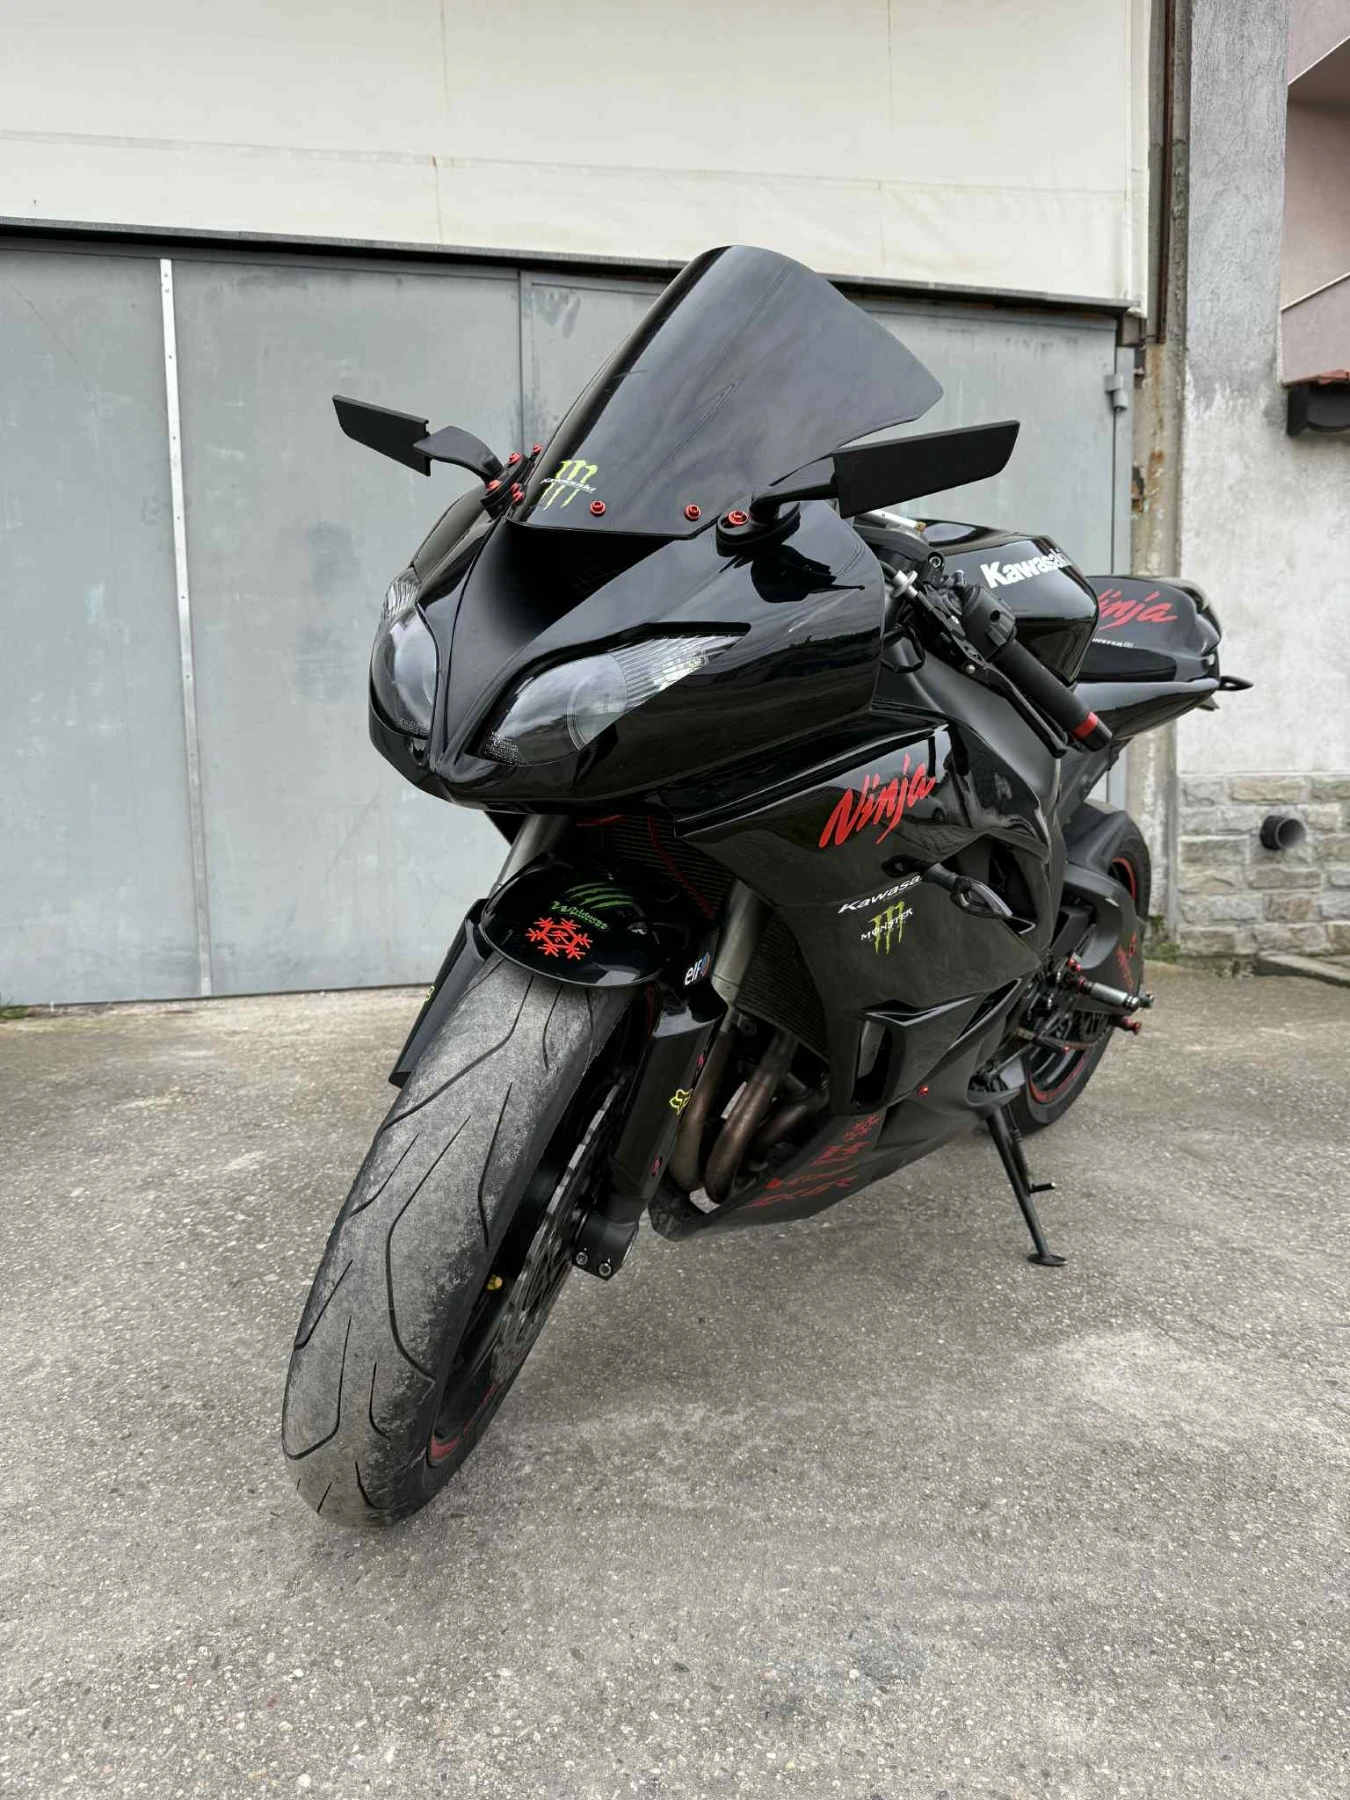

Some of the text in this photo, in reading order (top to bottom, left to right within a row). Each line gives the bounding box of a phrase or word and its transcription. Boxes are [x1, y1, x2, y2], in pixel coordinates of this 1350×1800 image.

[1097, 588, 1178, 630] inja
[818, 753, 936, 848] Ninja
[838, 875, 922, 913] Kawasa
[861, 907, 913, 940] MONSTER
